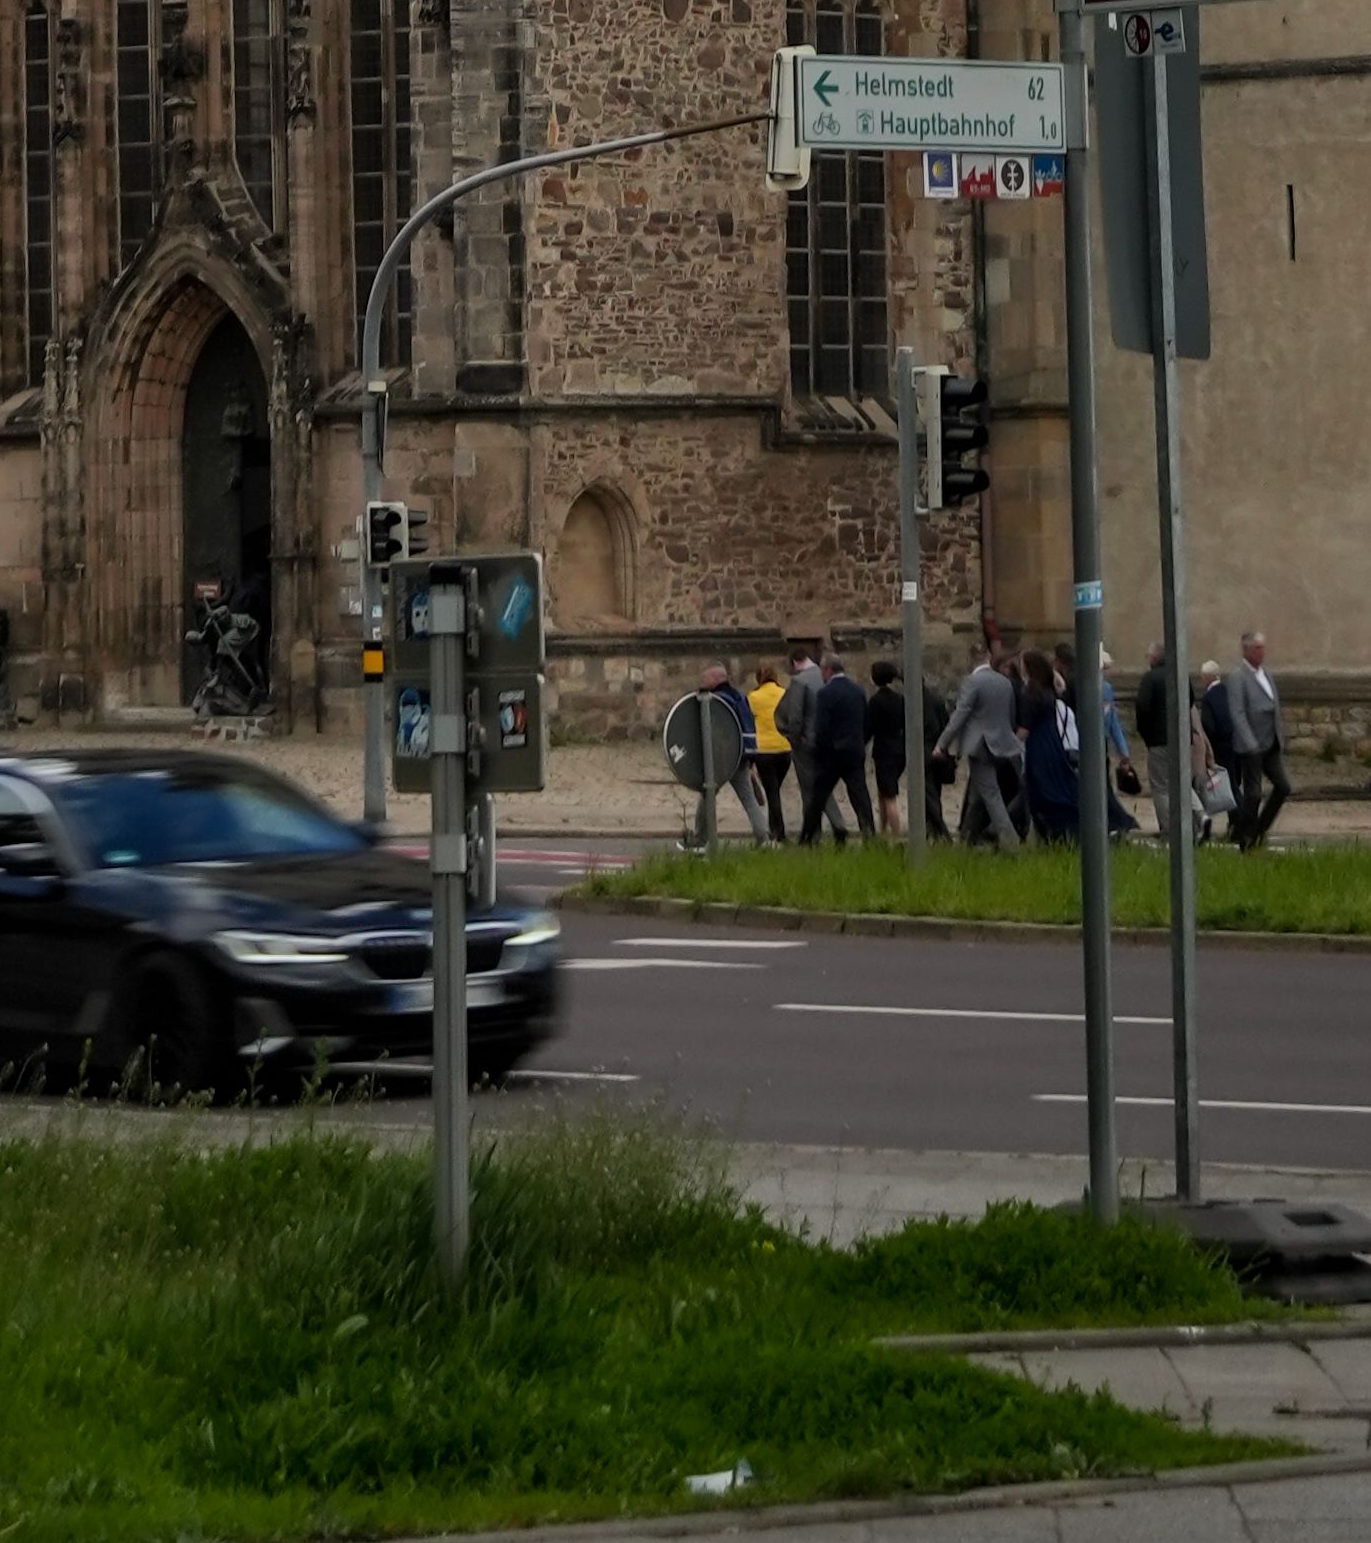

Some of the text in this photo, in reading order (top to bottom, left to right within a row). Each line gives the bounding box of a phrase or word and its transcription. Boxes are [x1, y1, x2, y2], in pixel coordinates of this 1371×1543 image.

[855, 71, 1045, 101] Helmstedt 62
[880, 110, 1058, 141] Hauptbahnhof 1,0
